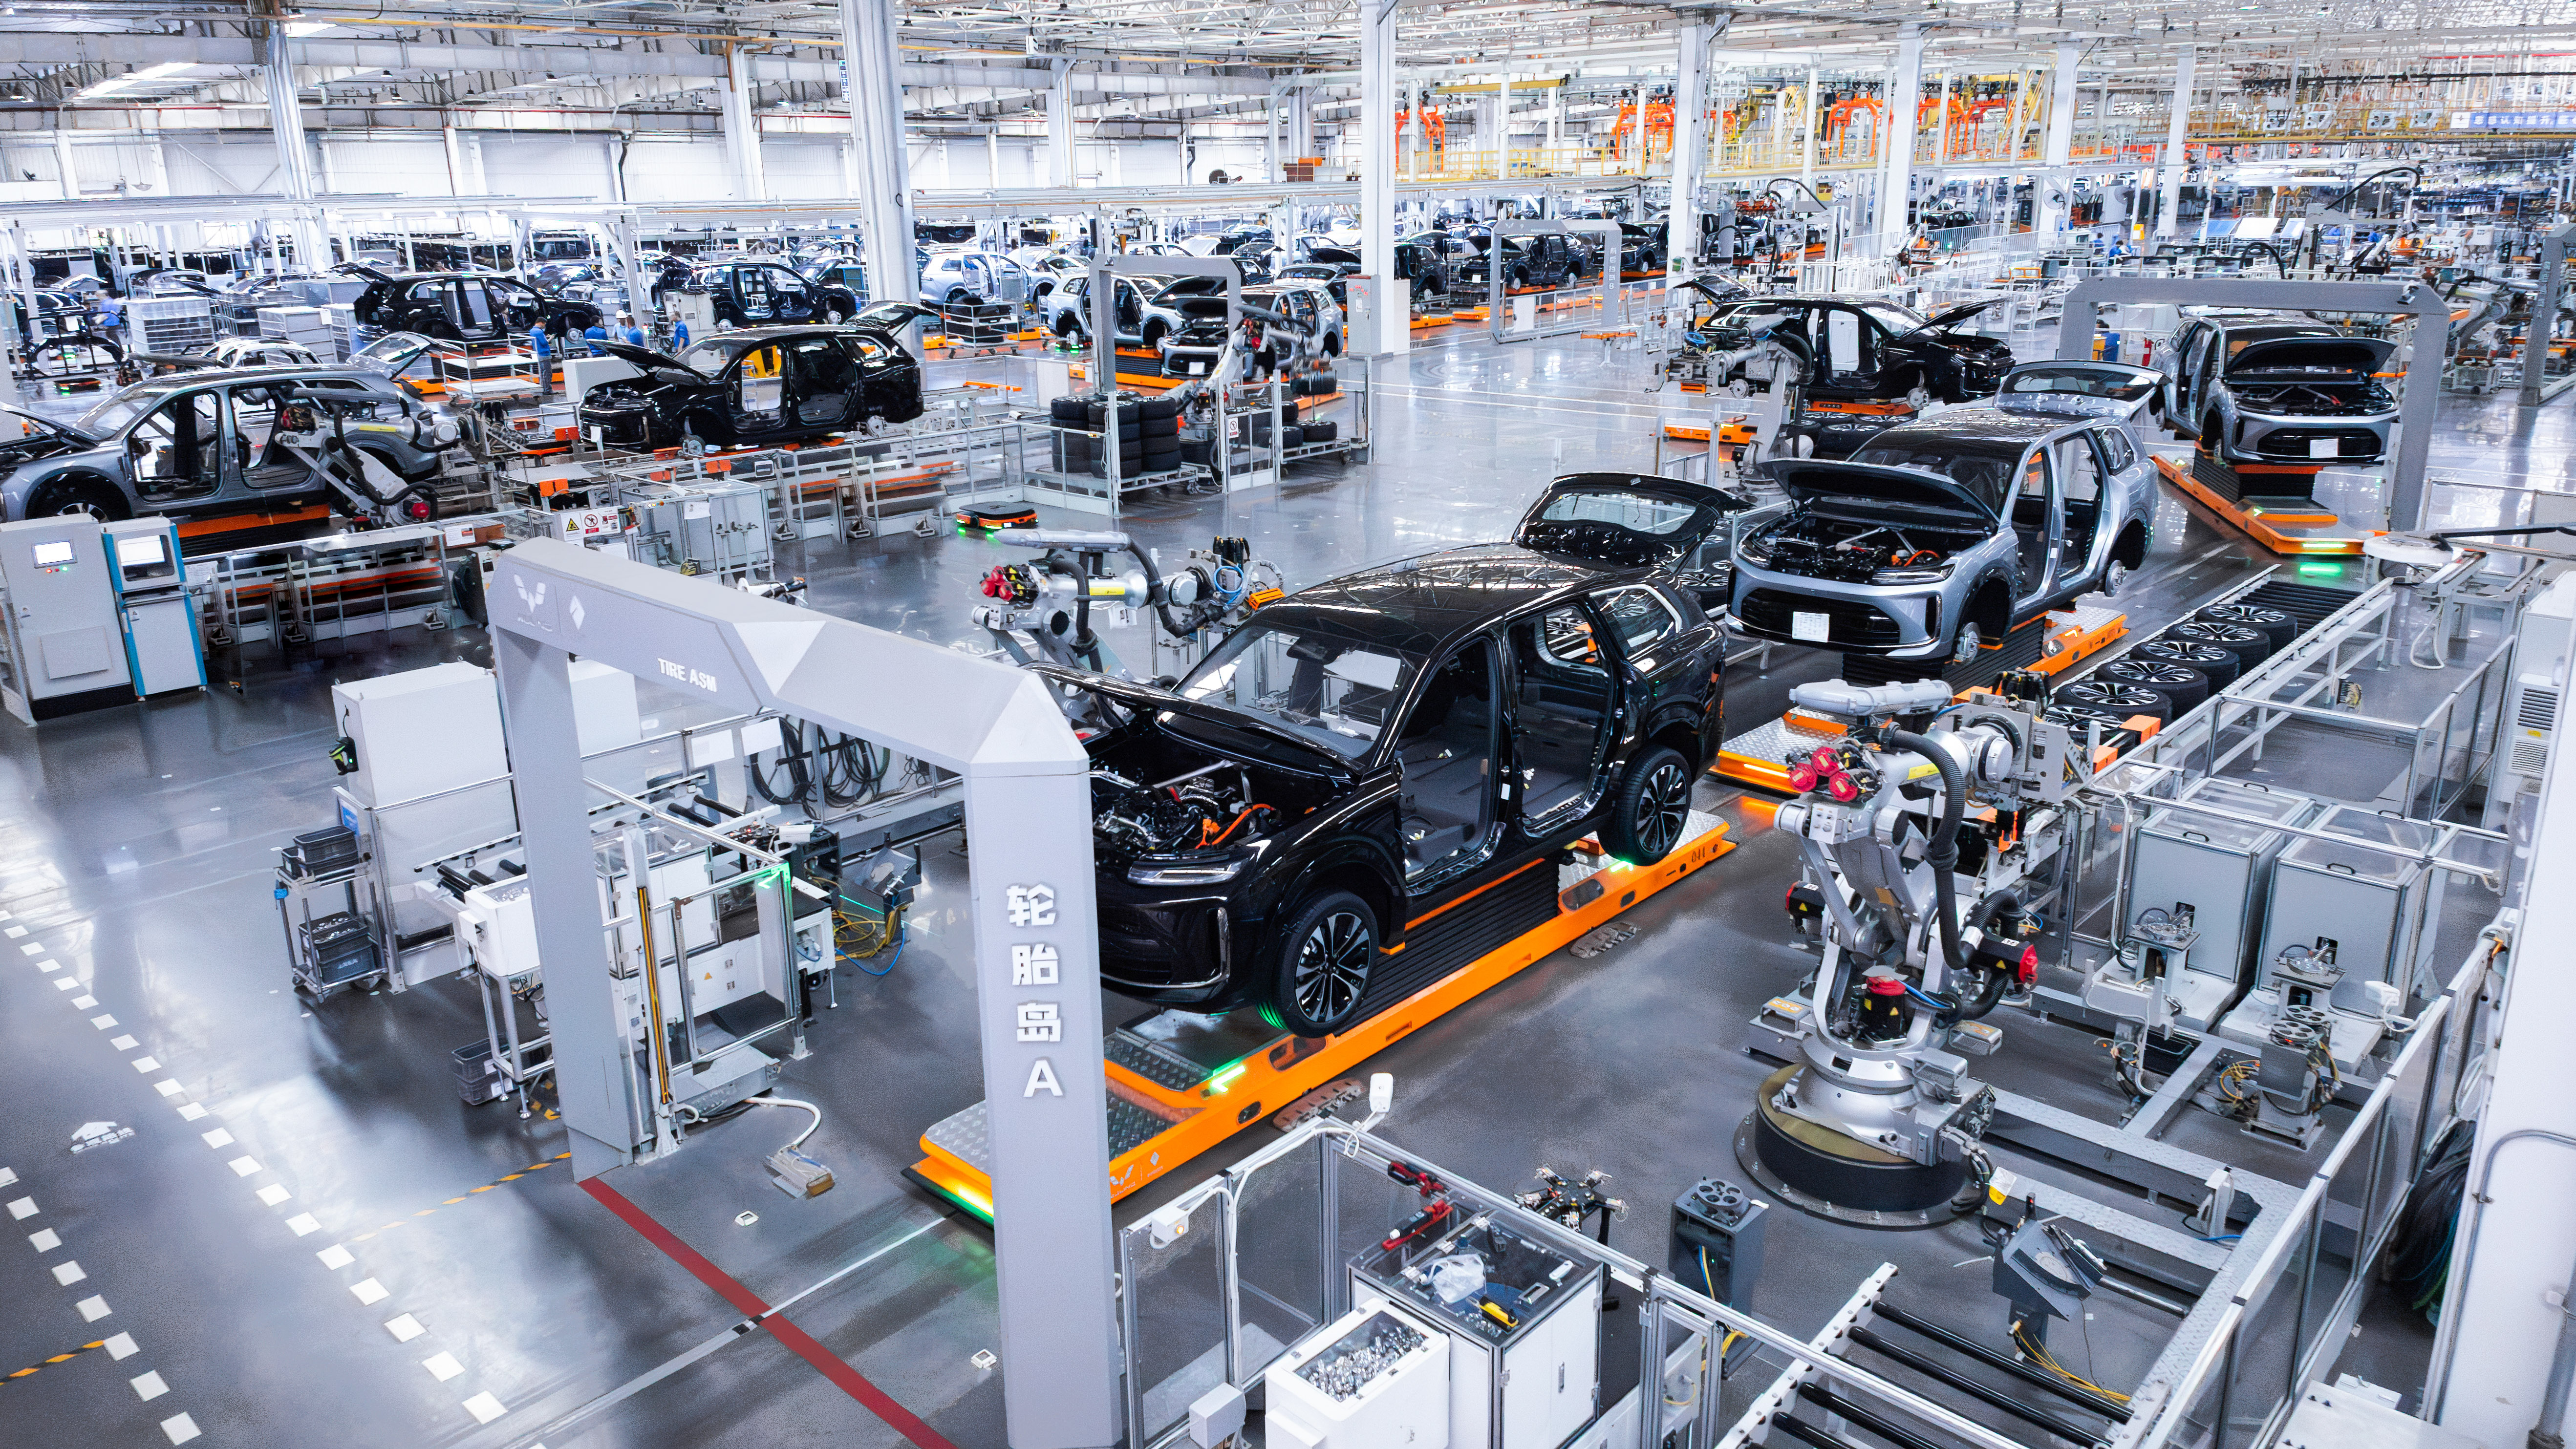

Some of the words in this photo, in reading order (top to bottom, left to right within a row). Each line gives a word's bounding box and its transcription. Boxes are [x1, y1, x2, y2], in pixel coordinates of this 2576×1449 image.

[657, 658, 687, 682] TIRE
[689, 668, 717, 692] ASM
[1007, 883, 1063, 1098] 轮胎岛A
